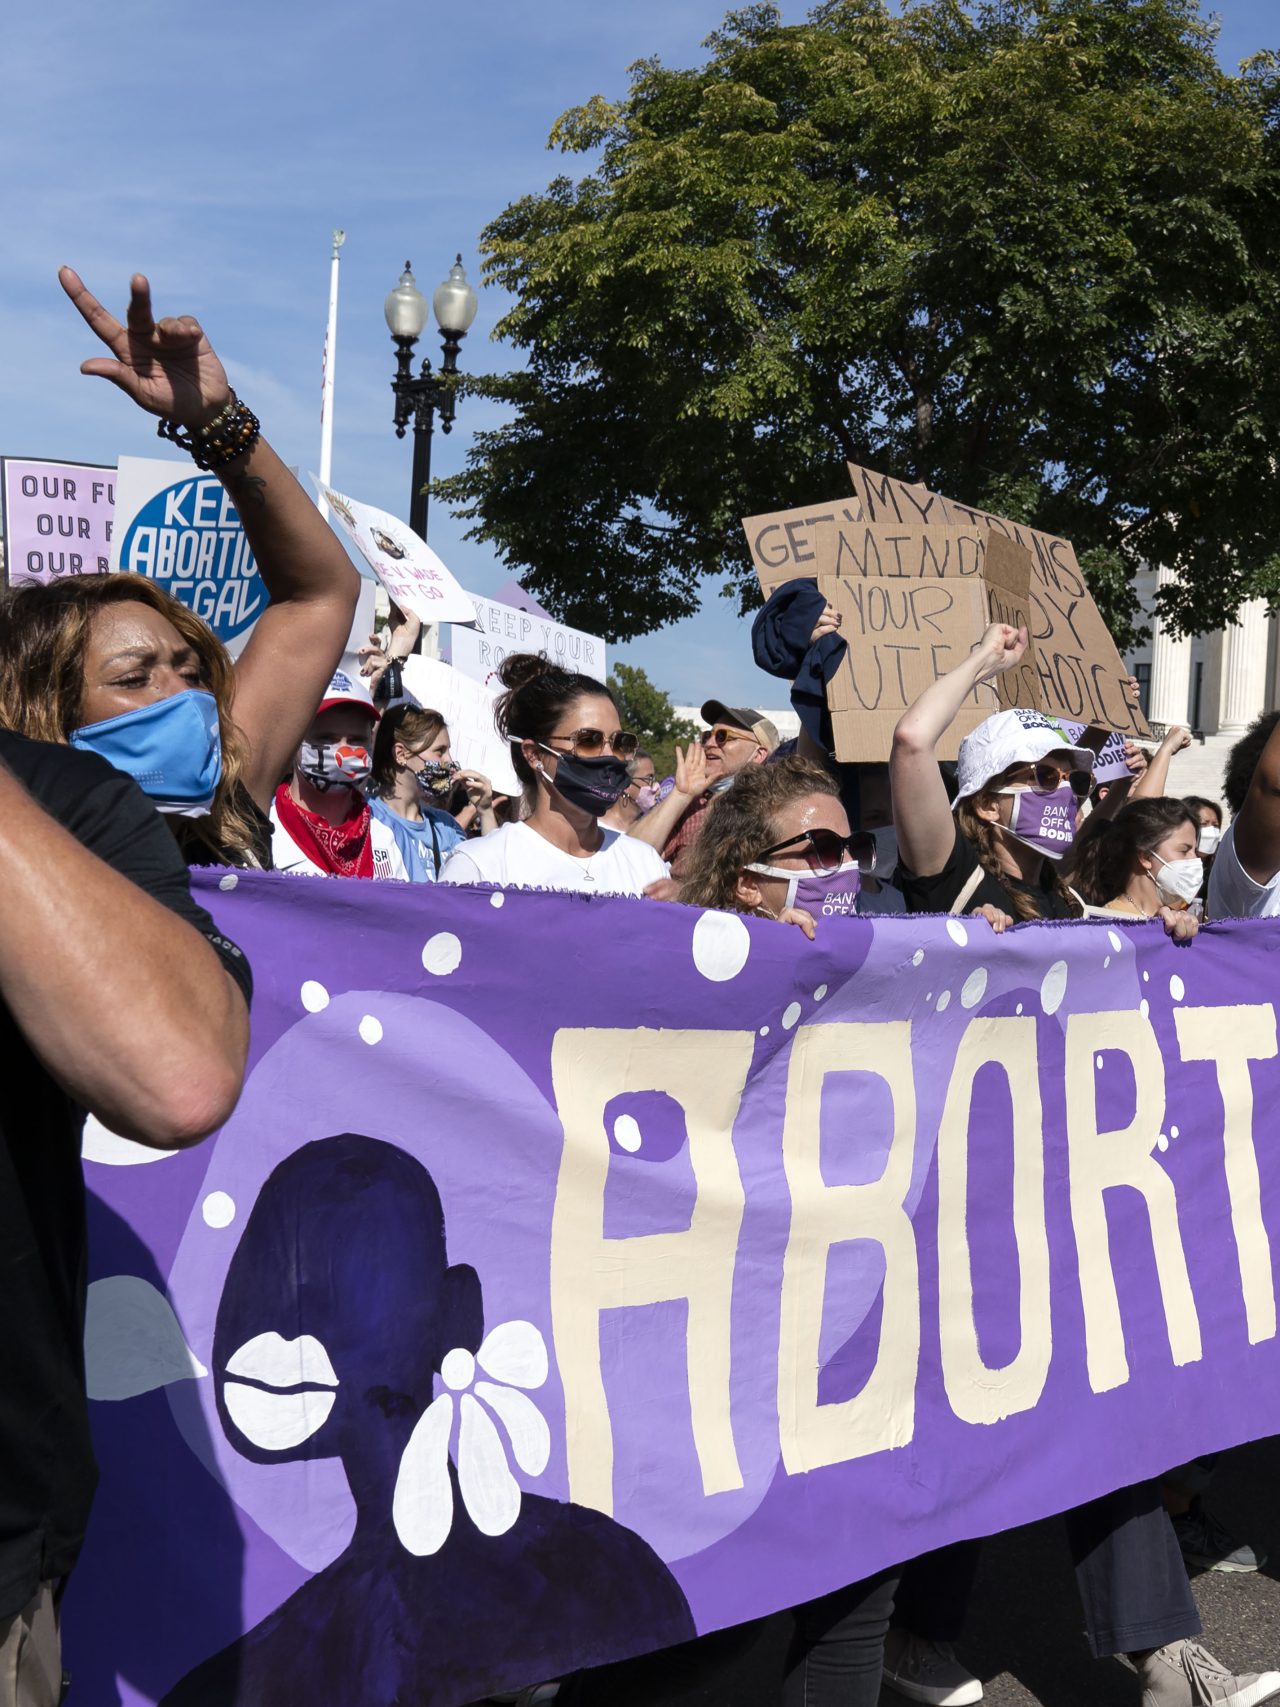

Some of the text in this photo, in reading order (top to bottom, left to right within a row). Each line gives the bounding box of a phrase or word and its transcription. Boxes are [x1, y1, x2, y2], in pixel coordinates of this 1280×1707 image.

[21, 475, 76, 501] OUR
[164, 479, 242, 528] KEE
[36, 513, 90, 540] OUR
[27, 551, 83, 575] OUR
[129, 526, 262, 579] ABORTIO
[836, 527, 979, 579] MIND
[170, 579, 262, 628] EGAL
[843, 579, 954, 634] YOUR
[472, 600, 532, 641] KEEP
[541, 624, 596, 665] YOUR
[1036, 647, 1151, 738] HOICE
[1039, 826, 1073, 842] BODIE
[1041, 816, 1064, 828] OFF
